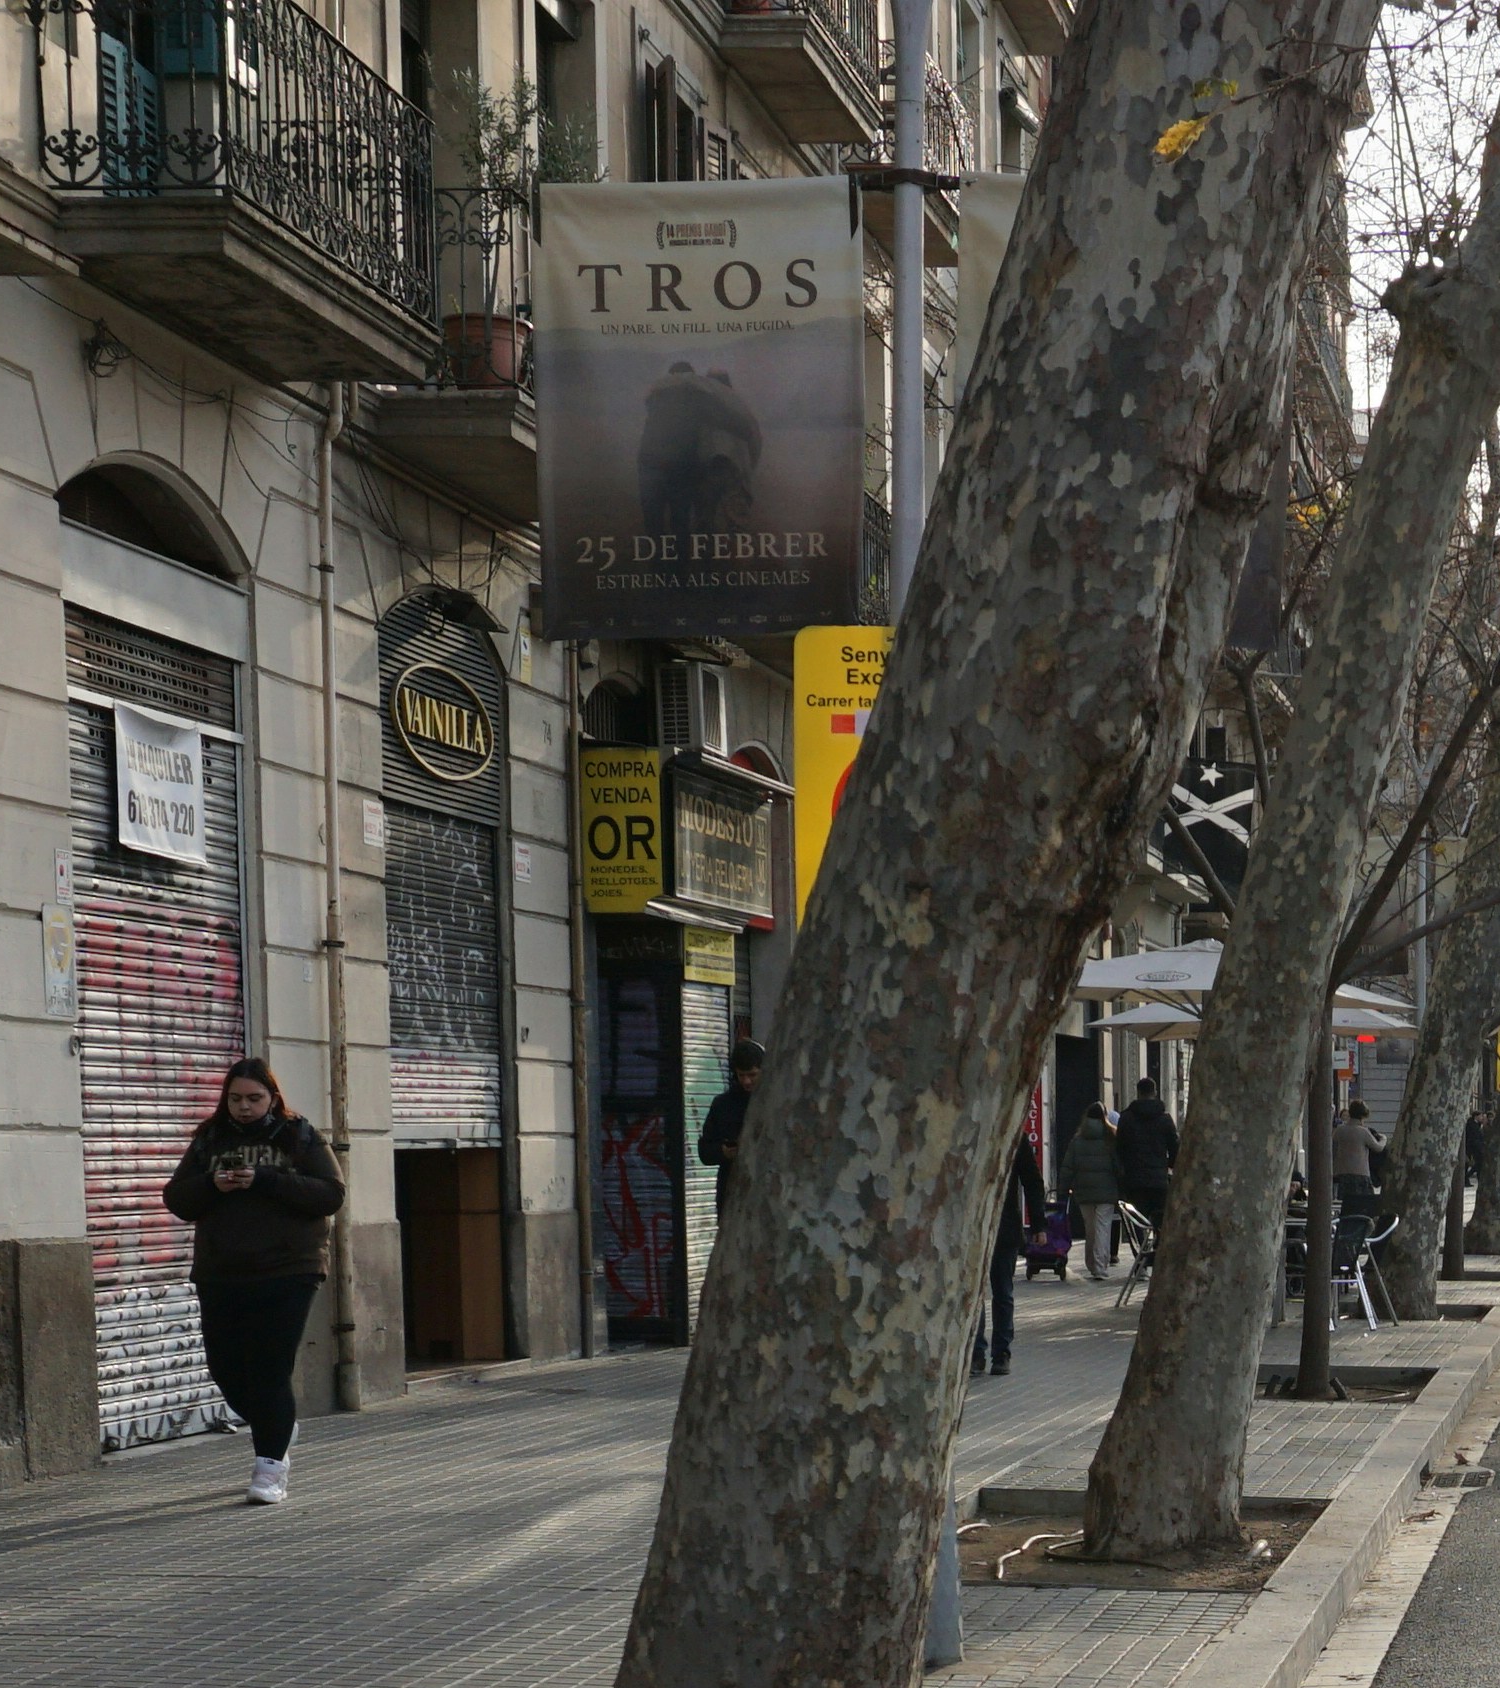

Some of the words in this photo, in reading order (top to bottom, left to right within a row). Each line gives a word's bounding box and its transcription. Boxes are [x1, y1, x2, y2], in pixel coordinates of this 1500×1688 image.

[577, 258, 818, 313] TROS
[601, 323, 619, 335] UN
[622, 323, 655, 335] PARE.
[661, 323, 681, 334] UN
[683, 323, 711, 334] FILL.
[717, 322, 743, 333] UNA
[746, 320, 795, 333] FUGIDA.
[576, 536, 616, 571] 25
[632, 534, 679, 562] DE
[690, 531, 828, 560] FEBRER
[596, 573, 681, 589] ESTRENA
[686, 571, 720, 587] ALS
[725, 569, 810, 586] CINEMES
[806, 694, 854, 707] Carrer
[859, 695, 875, 707] ta
[403, 686, 487, 756] VAINILLA
[542, 719, 553, 746] 74
[585, 761, 656, 778] COMPRA
[590, 787, 652, 804] VENDA
[680, 791, 753, 848] MODESTO
[587, 815, 657, 860] OR
